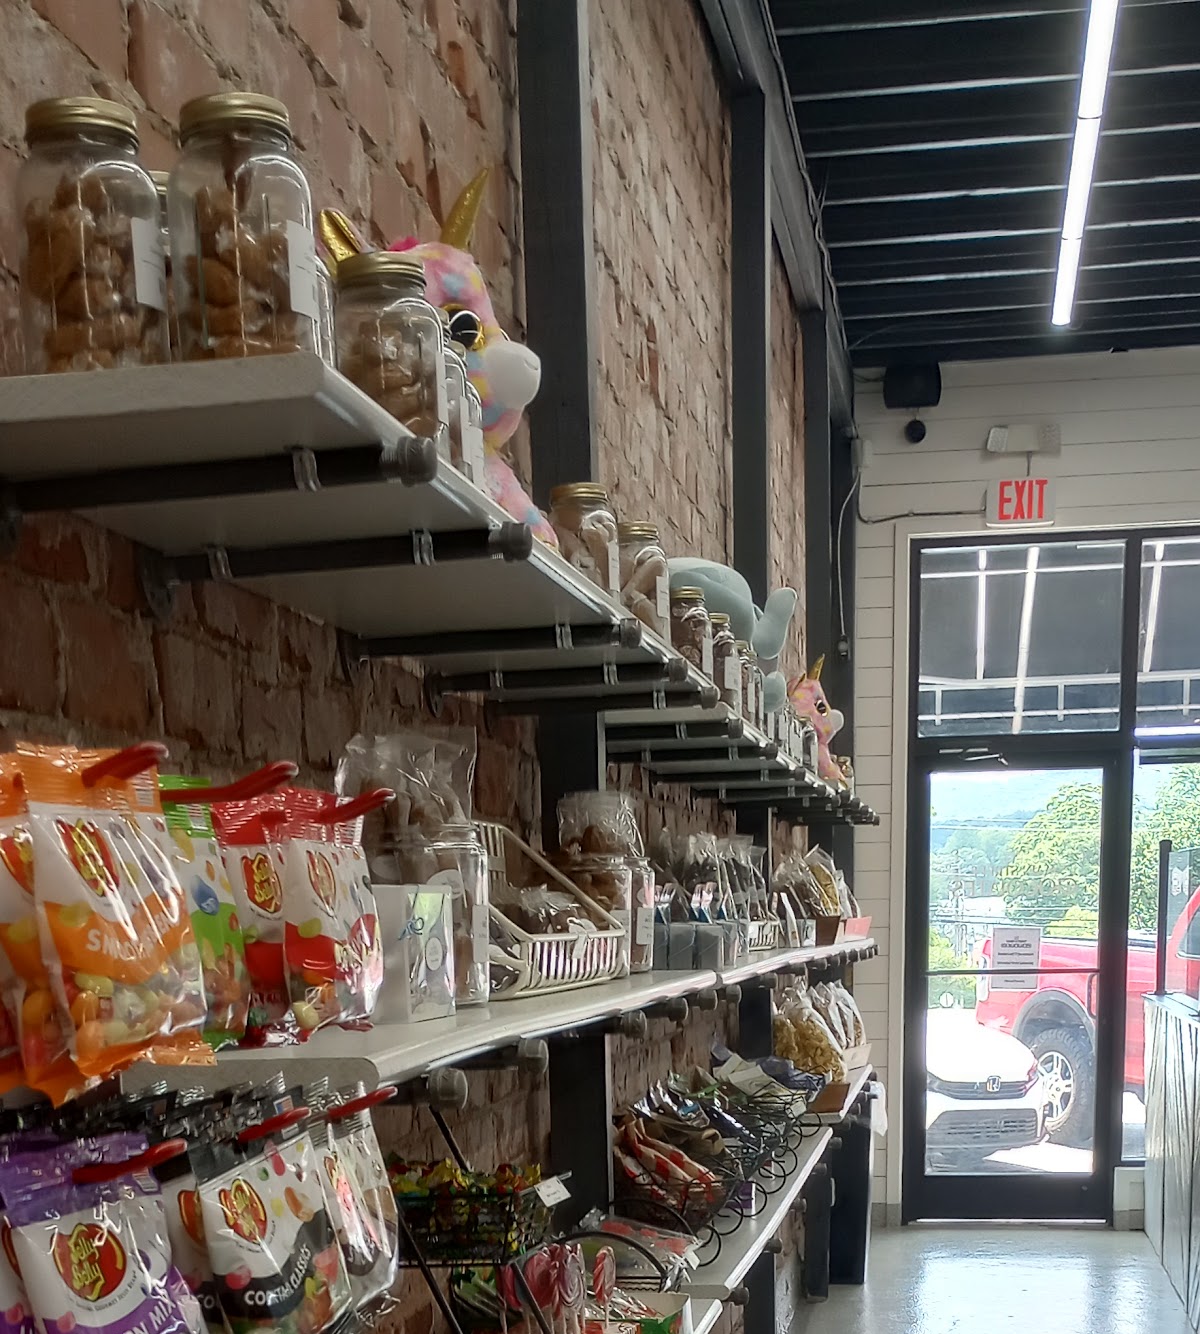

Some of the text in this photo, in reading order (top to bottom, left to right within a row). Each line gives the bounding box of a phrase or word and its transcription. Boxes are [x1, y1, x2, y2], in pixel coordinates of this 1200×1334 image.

[998, 479, 1048, 520] EXIT
[69, 1223, 100, 1264] Jelly
[72, 1258, 105, 1298] Belly
[148, 1295, 177, 1331] MIX
